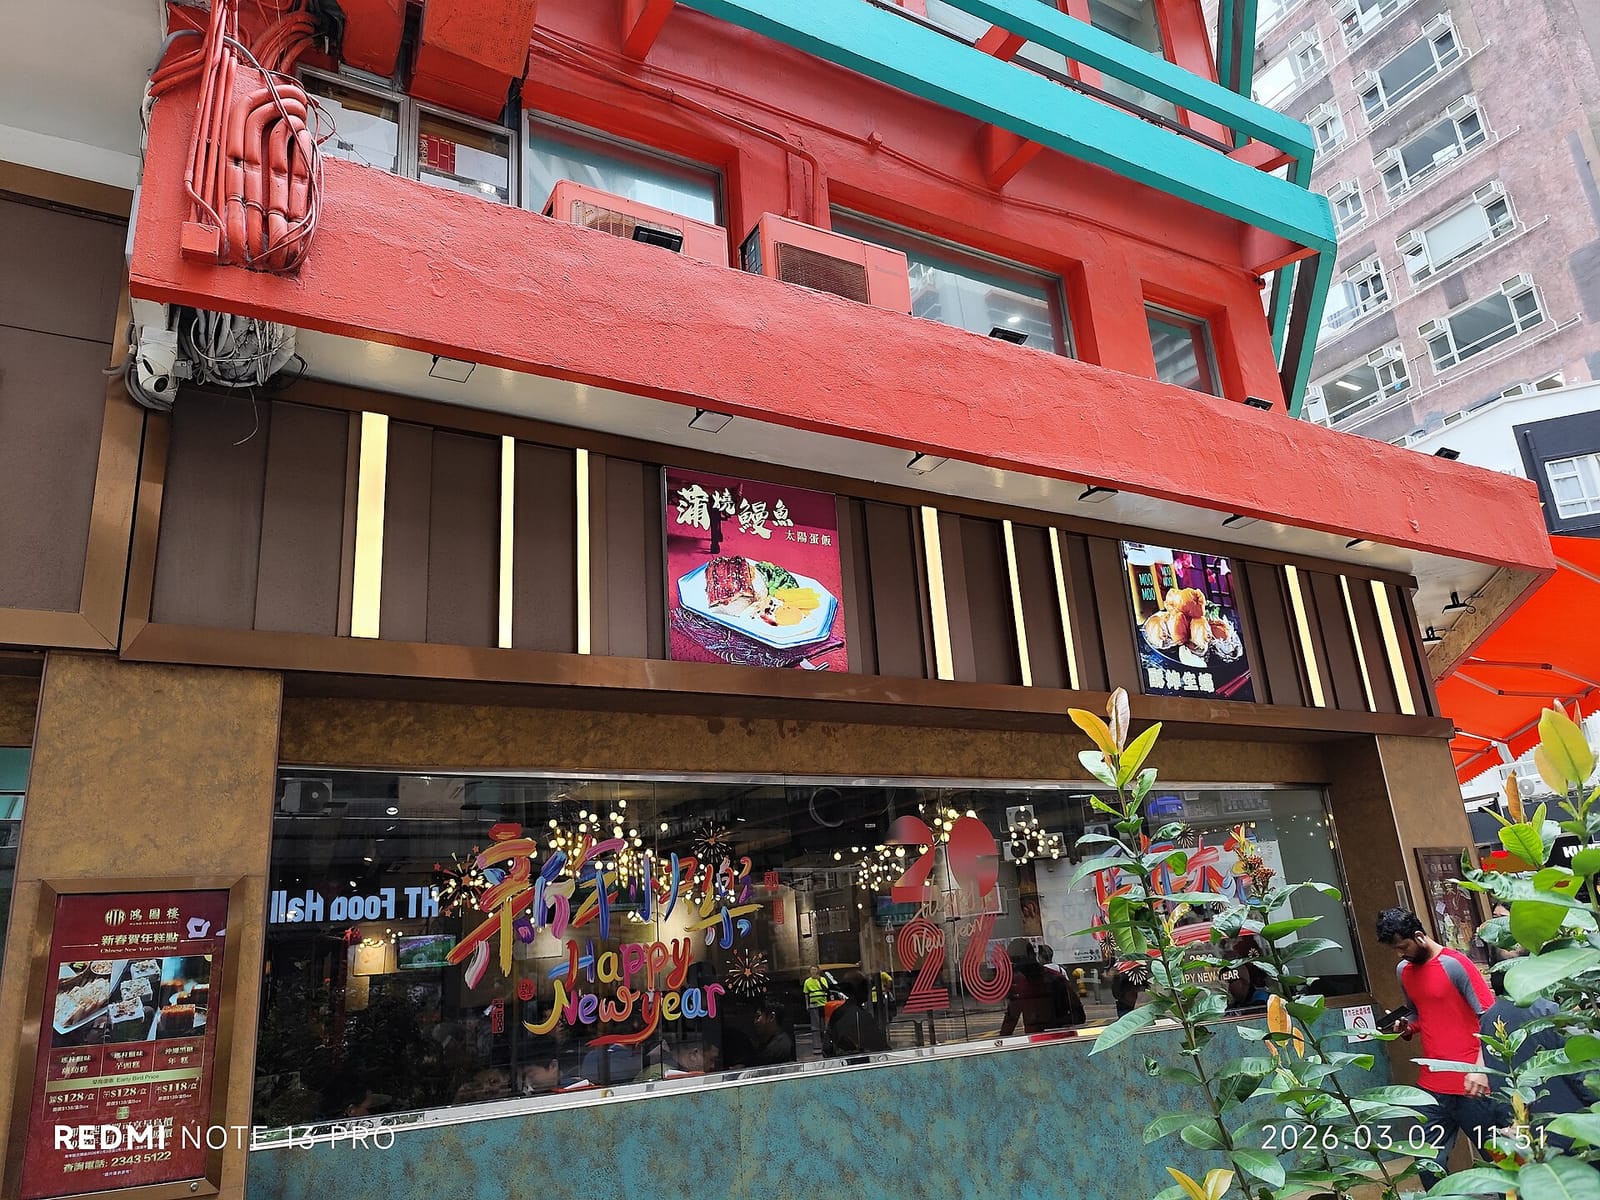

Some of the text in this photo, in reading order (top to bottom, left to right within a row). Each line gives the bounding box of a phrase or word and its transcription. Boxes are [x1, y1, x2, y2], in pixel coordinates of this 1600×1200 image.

[676, 484, 794, 540] 蒲燒鰻魚
[784, 529, 833, 548] 太陽蛋飯
[101, 931, 180, 946] 新春賀年糕點
[547, 937, 692, 992] Happy
[110, 1154, 142, 1167] 2343
[143, 1151, 172, 1164] 5122
